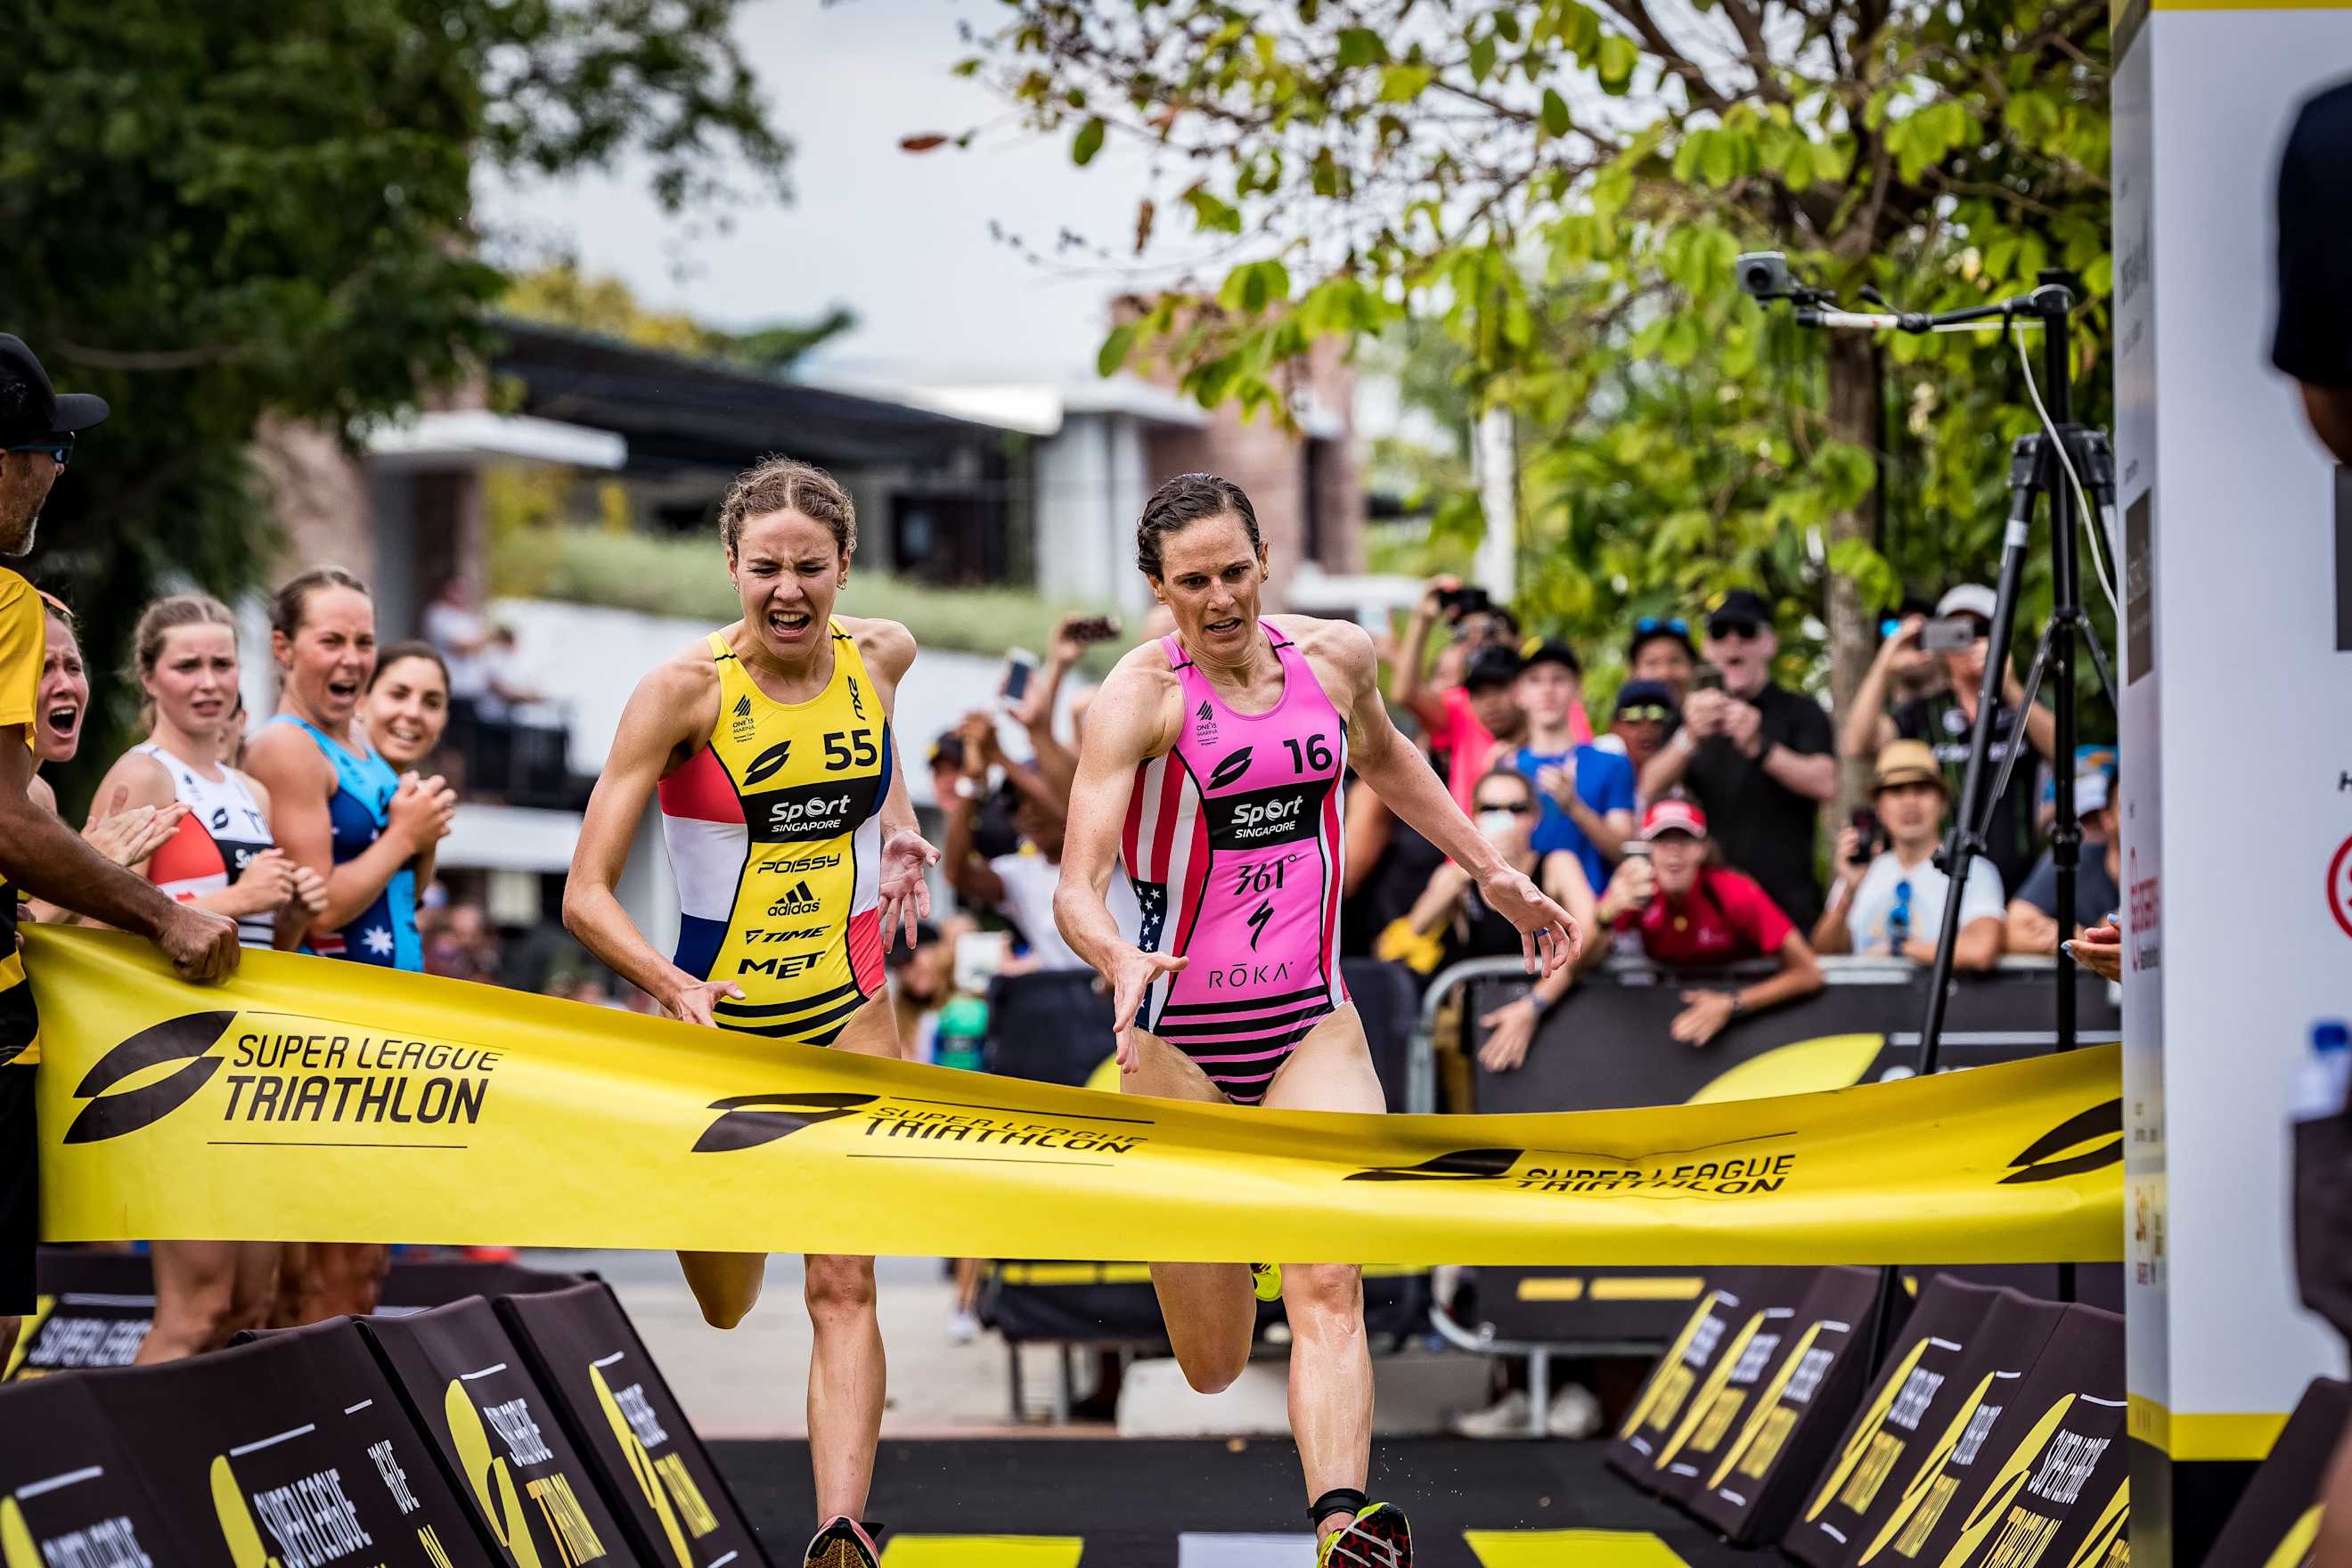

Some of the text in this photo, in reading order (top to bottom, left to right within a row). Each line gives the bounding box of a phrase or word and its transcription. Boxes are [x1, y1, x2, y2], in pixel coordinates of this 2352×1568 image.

[822, 729, 878, 771] 55
[1282, 733, 1333, 774] 16
[768, 794, 852, 823] Sport
[1230, 795, 1303, 828] Sport
[771, 818, 842, 833] SINGAPORE
[1234, 820, 1296, 839] SINGAPORE
[757, 853, 841, 874] POISSY
[767, 901, 821, 917] adidas
[761, 925, 832, 943] TIME
[737, 950, 827, 980] MET
[233, 1033, 504, 1072] SUPER LEAGUE
[223, 1074, 490, 1124] TRIATHLON
[864, 1115, 1135, 1154] TRIATHLON
[873, 1107, 1149, 1144] SUPER LEAGUE
[1651, 1154, 1797, 1180] LEAGUE
